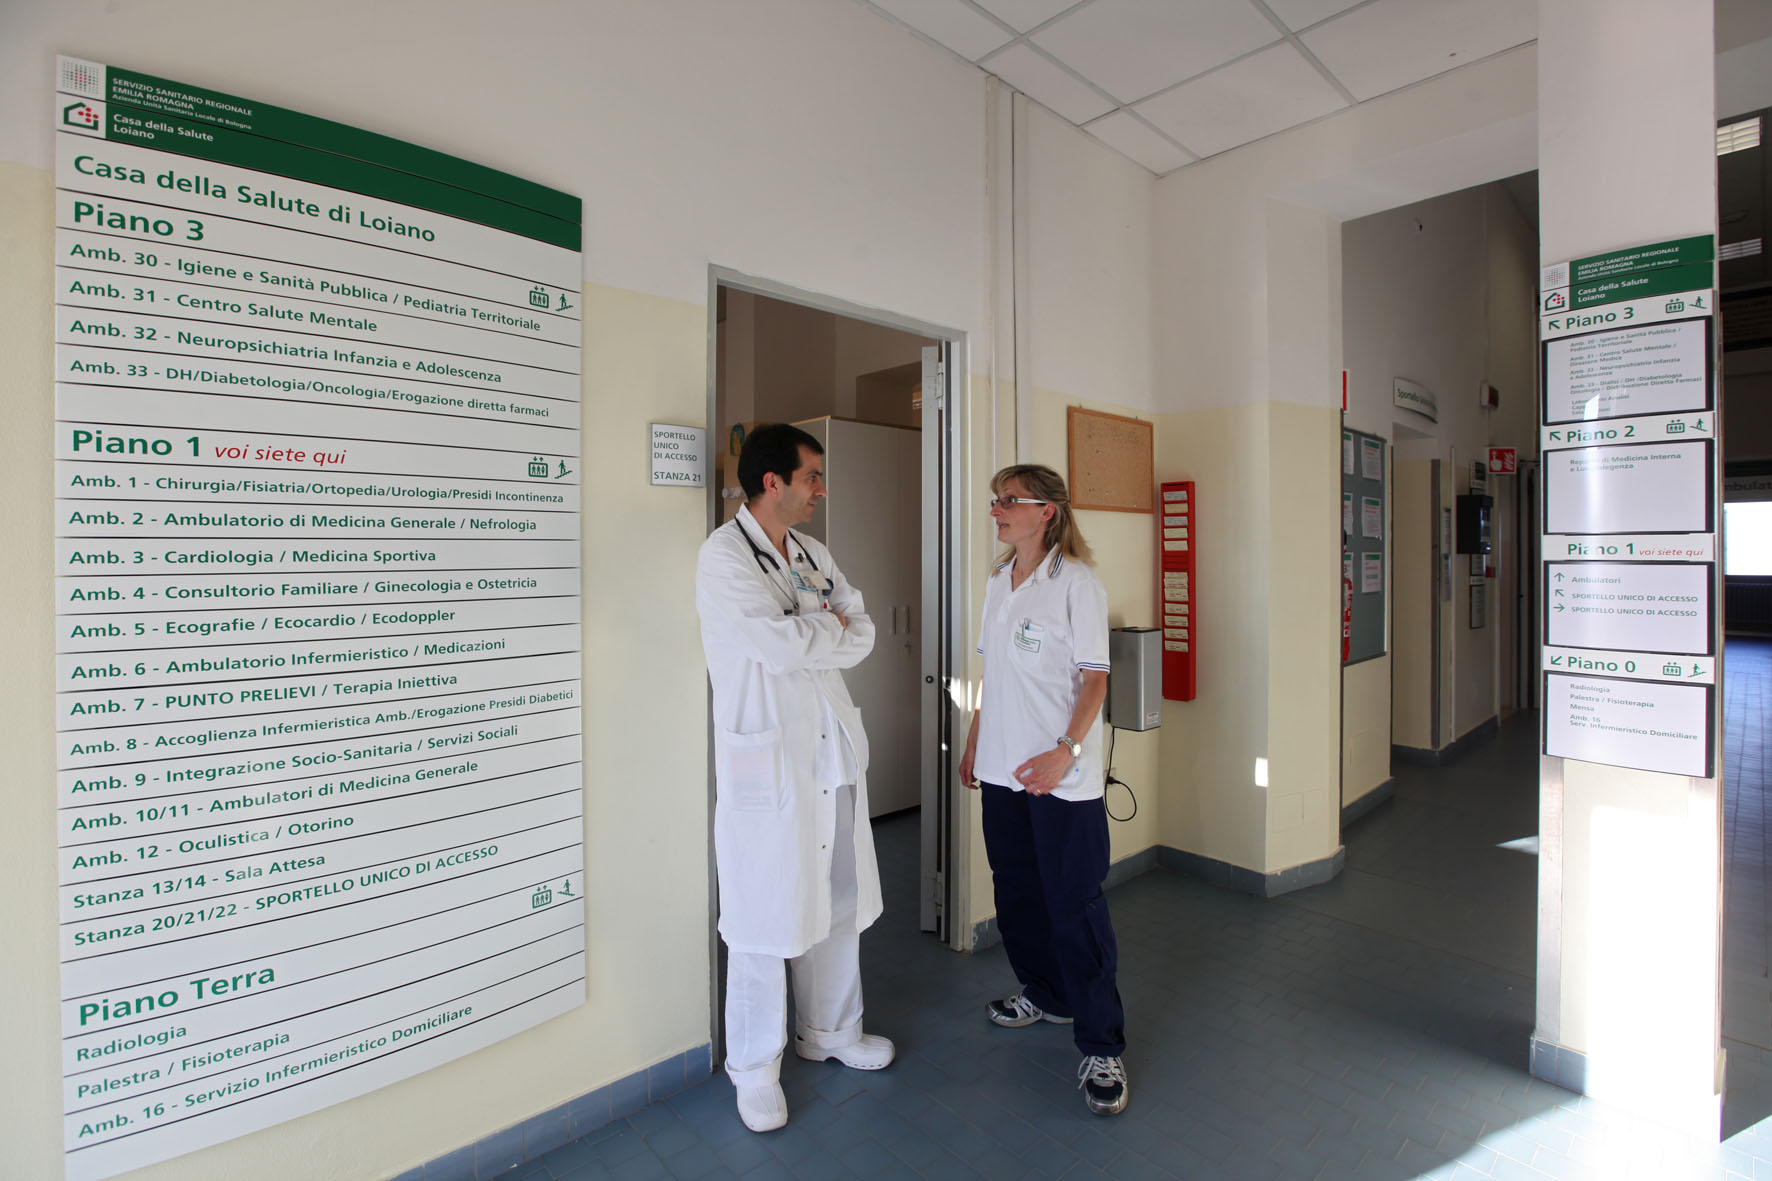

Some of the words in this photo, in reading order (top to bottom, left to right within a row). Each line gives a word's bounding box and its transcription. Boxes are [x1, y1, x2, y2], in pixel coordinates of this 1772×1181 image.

[113, 78, 153, 92] SERVIZIO
[156, 88, 203, 104] SANITARIO
[205, 99, 252, 116] REGIONALE
[113, 86, 144, 98] EMILIA
[146, 94, 194, 110] ROMAGNA
[113, 94, 141, 104] Azienda
[143, 100, 162, 109] Unità
[164, 105, 193, 116] Sanitaria
[195, 112, 215, 121] Locale
[226, 119, 252, 129] Bologna
[114, 113, 141, 126] Casa
[145, 120, 174, 133] della
[177, 127, 213, 141] Salute
[114, 124, 155, 139] Loiano
[73, 155, 146, 184] Casa
[156, 169, 227, 200] della
[237, 185, 321, 217] Salute
[327, 204, 351, 224] di
[359, 210, 435, 241] Loiano
[73, 201, 174, 236] Piano
[187, 220, 204, 240] 3
[1578, 261, 1604, 270] SERVIZIO
[1606, 254, 1640, 265] SANITARIO
[1641, 247, 1680, 258] REGIONALE
[1578, 267, 1598, 276] EMILIA
[1600, 261, 1634, 273] ROMAGNA
[69, 243, 125, 262] Amb.
[134, 251, 159, 268] 30
[177, 258, 236, 277] Igiene
[243, 271, 253, 281] e
[260, 271, 314, 290] Sanità
[319, 280, 387, 302] Pubblica
[403, 295, 467, 316] Pediatria
[471, 308, 540, 331] Territoriale
[1578, 288, 1596, 296] Casa
[1598, 283, 1619, 292] della
[1621, 278, 1648, 287] Salute
[1578, 293, 1605, 303] Loiano
[68, 280, 126, 300] Amb.
[132, 287, 155, 303] 31
[176, 293, 242, 313] Centro
[247, 303, 305, 321] Salute
[309, 311, 377, 330] Mentale
[1566, 312, 1617, 329] Piano
[1623, 307, 1634, 320] 3
[69, 319, 125, 337] Amb.
[132, 325, 157, 341] 32
[177, 331, 328, 359] Neuropsichiatria
[333, 349, 397, 368] Infanzia
[402, 361, 411, 369] e
[415, 360, 501, 383] Adolescenza
[69, 359, 119, 375] Amb.
[127, 364, 148, 376] 33
[166, 368, 463, 406] DH/Diabetologia/Oncologia/Erogazione
[466, 399, 506, 411] diretta
[509, 403, 548, 416] farmaci
[654, 431, 695, 441] SPORTELLO
[1567, 429, 1618, 442] Piano
[1624, 425, 1635, 437] 2
[72, 429, 172, 456] Piano
[185, 435, 200, 457] 1
[215, 443, 250, 460] voi
[255, 445, 307, 465] siete
[313, 449, 348, 468] qui
[654, 442, 679, 450] UNICO
[665, 453, 697, 461] ACCESSO
[1612, 455, 1648, 463] Medicina
[69, 474, 120, 488] Amb.
[128, 476, 136, 488] 1
[155, 477, 491, 500] Chirurgia/Fisiatria/Ortopedia/Urologia/Presidi
[495, 491, 563, 503] Incontinenza
[654, 472, 690, 480] STANZA
[693, 474, 701, 482] 21
[68, 549, 124, 565] Amb.
[131, 551, 145, 565] 3
[164, 549, 273, 567] Cardiologia
[292, 549, 368, 563] Medicina
[372, 549, 436, 564] Sportiva
[1626, 543, 1634, 555] 1
[1639, 548, 1654, 556] voi
[1657, 548, 1682, 556] siete
[1686, 548, 1704, 557] qui
[1572, 576, 1621, 584] Ambulatori
[69, 623, 125, 639] Amb.
[133, 623, 146, 636] 5
[165, 617, 255, 637] Ecografie
[274, 613, 355, 630] Ecocardio
[372, 610, 455, 626] Ecodoppler
[70, 663, 127, 680] Amb.
[133, 662, 145, 676] 6
[165, 655, 286, 674] Ambulatorio
[291, 647, 409, 665] Infermieristico
[423, 640, 505, 656] Medicazioni
[1568, 656, 1618, 672] Piano
[1625, 660, 1636, 673] 0
[1570, 684, 1610, 693] Radiologia
[1570, 694, 1599, 702] Palestra
[1607, 698, 1654, 708] Fisioterapia
[1570, 714, 1589, 722] Amb.
[1570, 720, 1588, 728] Serv.
[1590, 723, 1647, 735] Infermieristico
[1650, 730, 1698, 740] Domiciliare
[71, 850, 127, 870] Amb.
[136, 845, 158, 860] 12
[178, 831, 269, 854] Oculistica
[287, 817, 353, 836] Otorino
[73, 888, 145, 909] Stanza
[151, 874, 205, 895] 13/14
[224, 865, 262, 883] Sala
[268, 856, 325, 875] Attesa
[73, 924, 145, 947] Stanza
[151, 903, 237, 932] 20/21/22
[256, 879, 354, 910] SPORTELLO
[359, 866, 411, 888] UNICO
[415, 861, 430, 875] DI
[434, 845, 499, 870] ACCESSO
[79, 989, 178, 1026] Piano
[190, 968, 274, 1000] Terra
[77, 1026, 187, 1062] Radiologia
[77, 1069, 160, 1099] Palestra
[181, 1033, 289, 1072] Fisioterapia
[77, 1114, 134, 1139] Amb.
[142, 1103, 164, 1120] 16
[184, 1077, 259, 1108] Servizio
[265, 1037, 387, 1084] Infermieristico
[392, 1007, 472, 1042] Domiciliare
